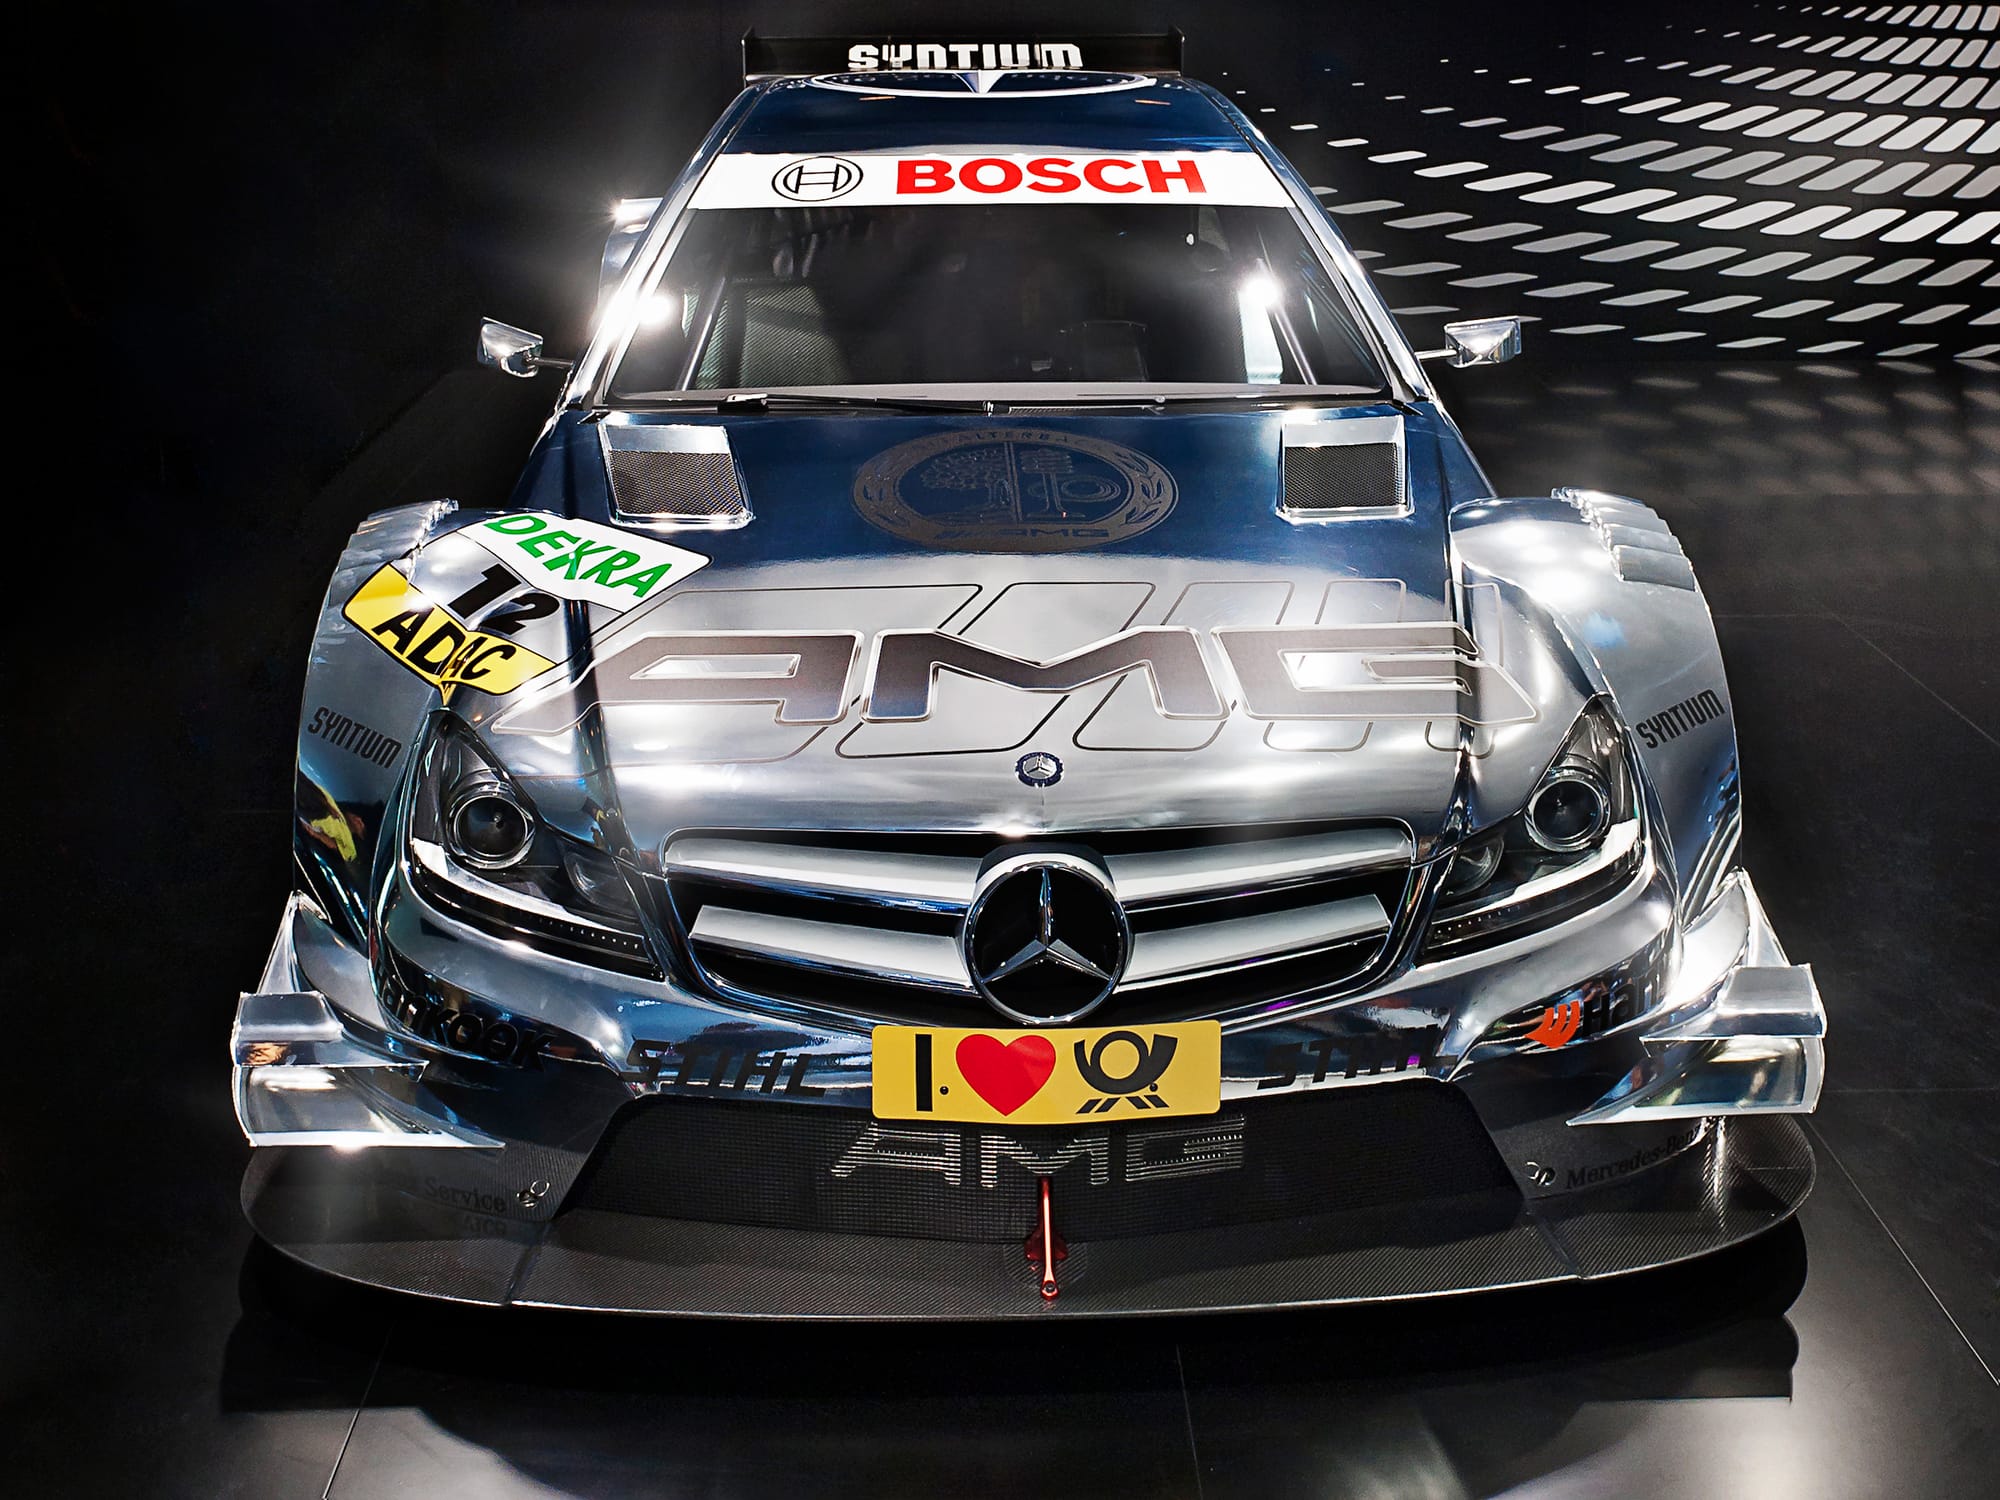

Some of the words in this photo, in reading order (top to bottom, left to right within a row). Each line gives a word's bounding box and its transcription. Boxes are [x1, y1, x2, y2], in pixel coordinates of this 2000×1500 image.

[848, 43, 1084, 69] SYNTIUM
[896, 157, 1207, 194] BOSCH
[484, 515, 672, 598] DEKRA
[448, 564, 560, 635] 12
[372, 608, 516, 680] ADAC
[490, 625, 1540, 735] AMG
[307, 706, 402, 769] SYNTIUM
[1635, 688, 1726, 749] SYNTIUM
[621, 1038, 828, 1097] STIHL
[914, 1033, 933, 1112] I
[1256, 1024, 1459, 1090] STIHL
[830, 1115, 1246, 1188] AMG
[424, 1175, 507, 1214] Service
